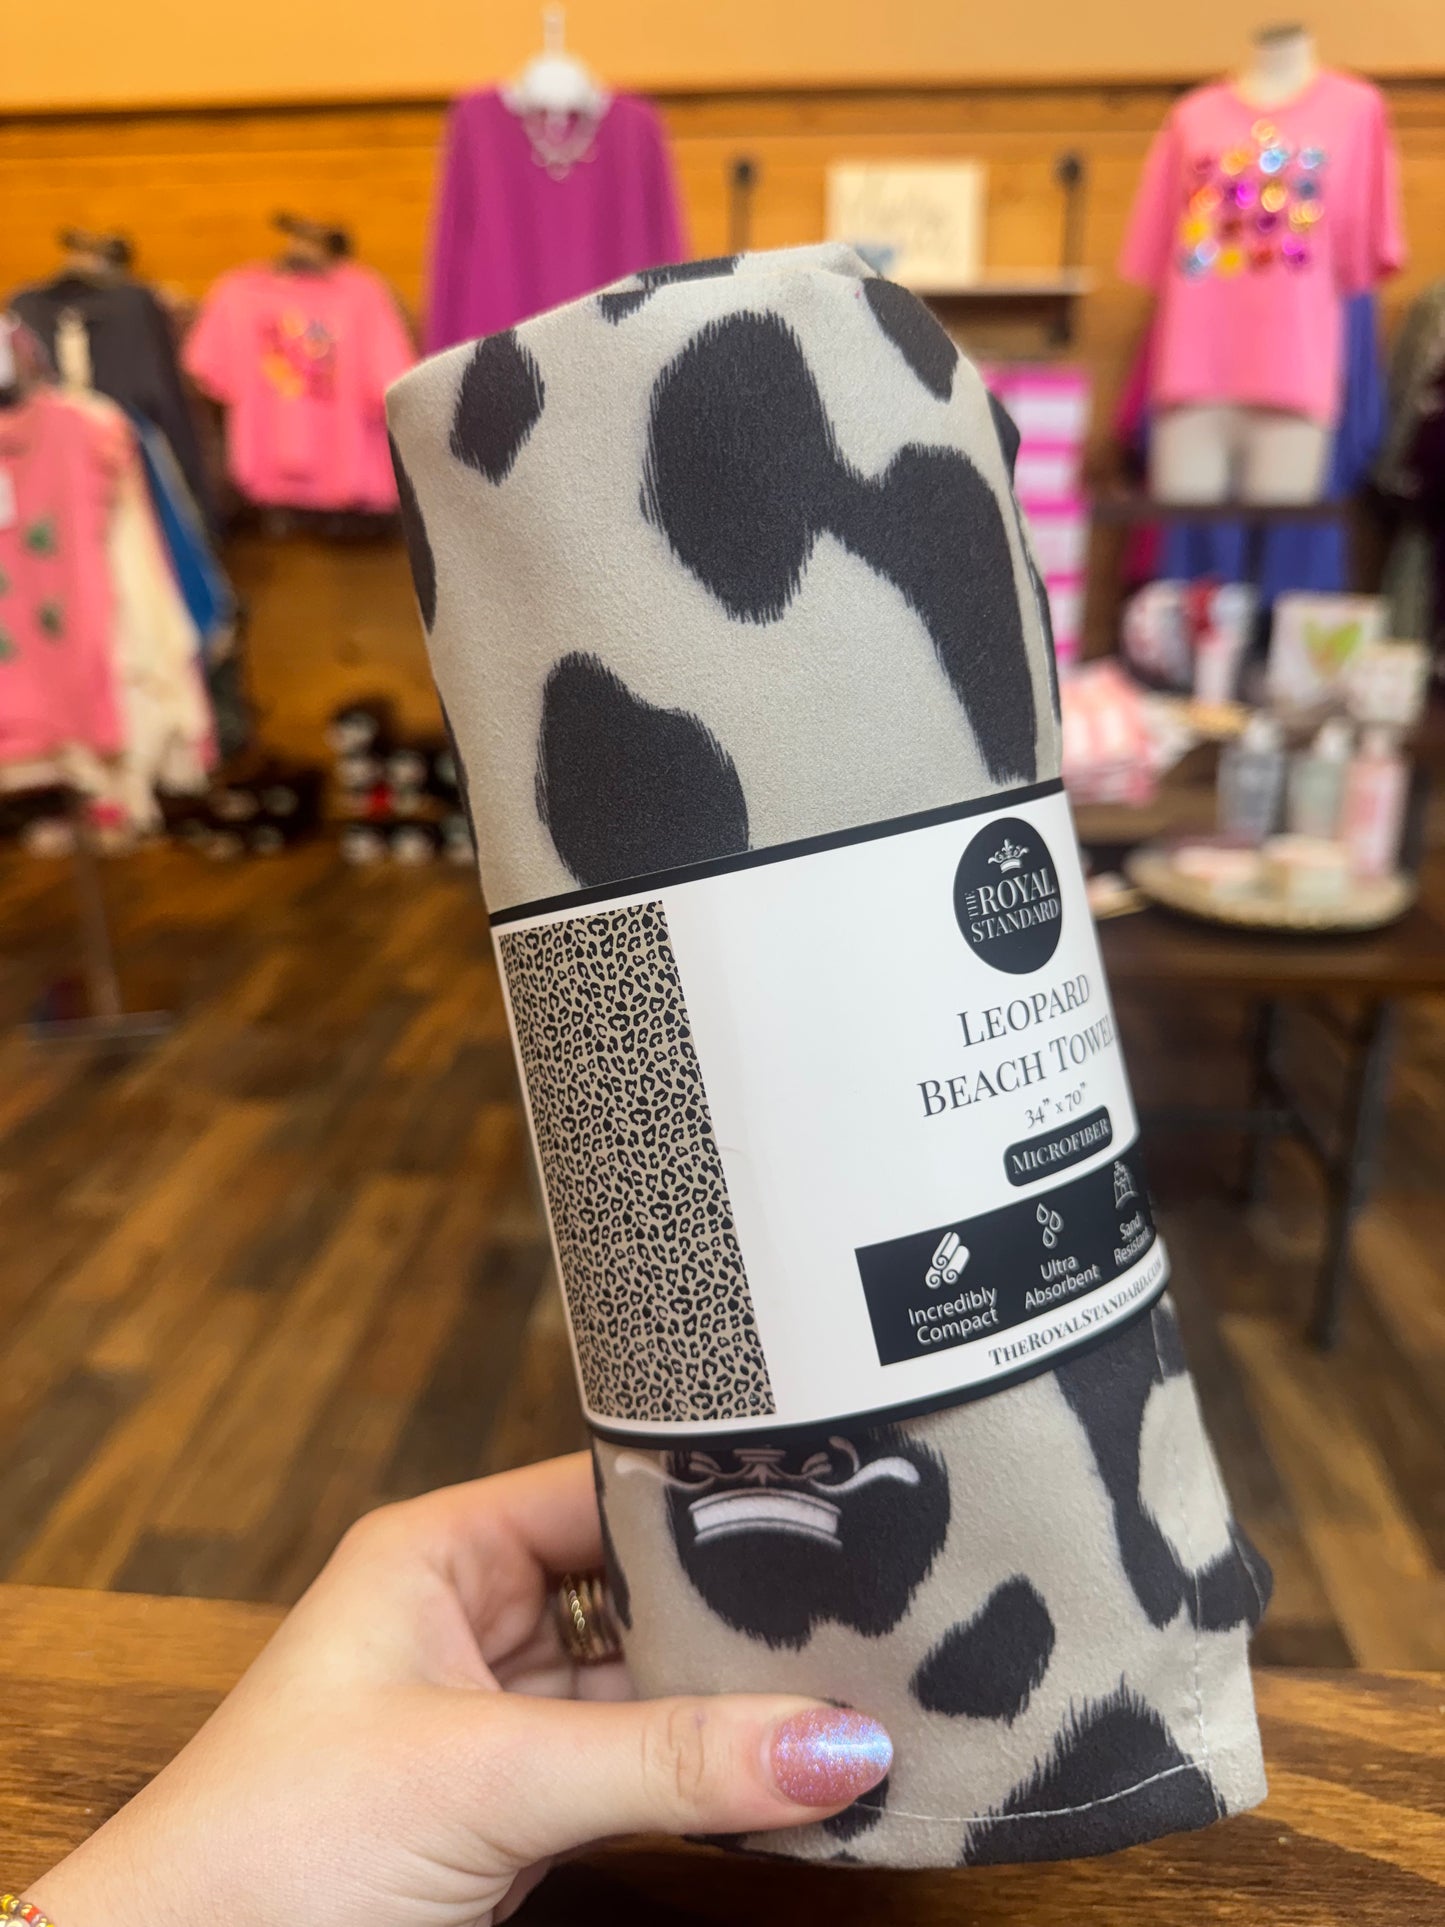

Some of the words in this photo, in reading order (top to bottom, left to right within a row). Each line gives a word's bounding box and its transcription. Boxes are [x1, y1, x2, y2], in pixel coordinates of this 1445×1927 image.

[966, 891, 979, 920] THE
[977, 868, 1056, 916] ROYAL
[971, 899, 1059, 943] STANDARD
[957, 974, 1090, 1047] LEOPARD
[917, 1050, 1047, 1118] BEACH
[1011, 1118, 1110, 1175] MICROFIBER
[1119, 1210, 1143, 1240] Sand
[1024, 1264, 1099, 1310] Absorbent
[1040, 1255, 1077, 1281] Ultra
[908, 1287, 998, 1326] Incredibly
[916, 1307, 999, 1345] Compact
